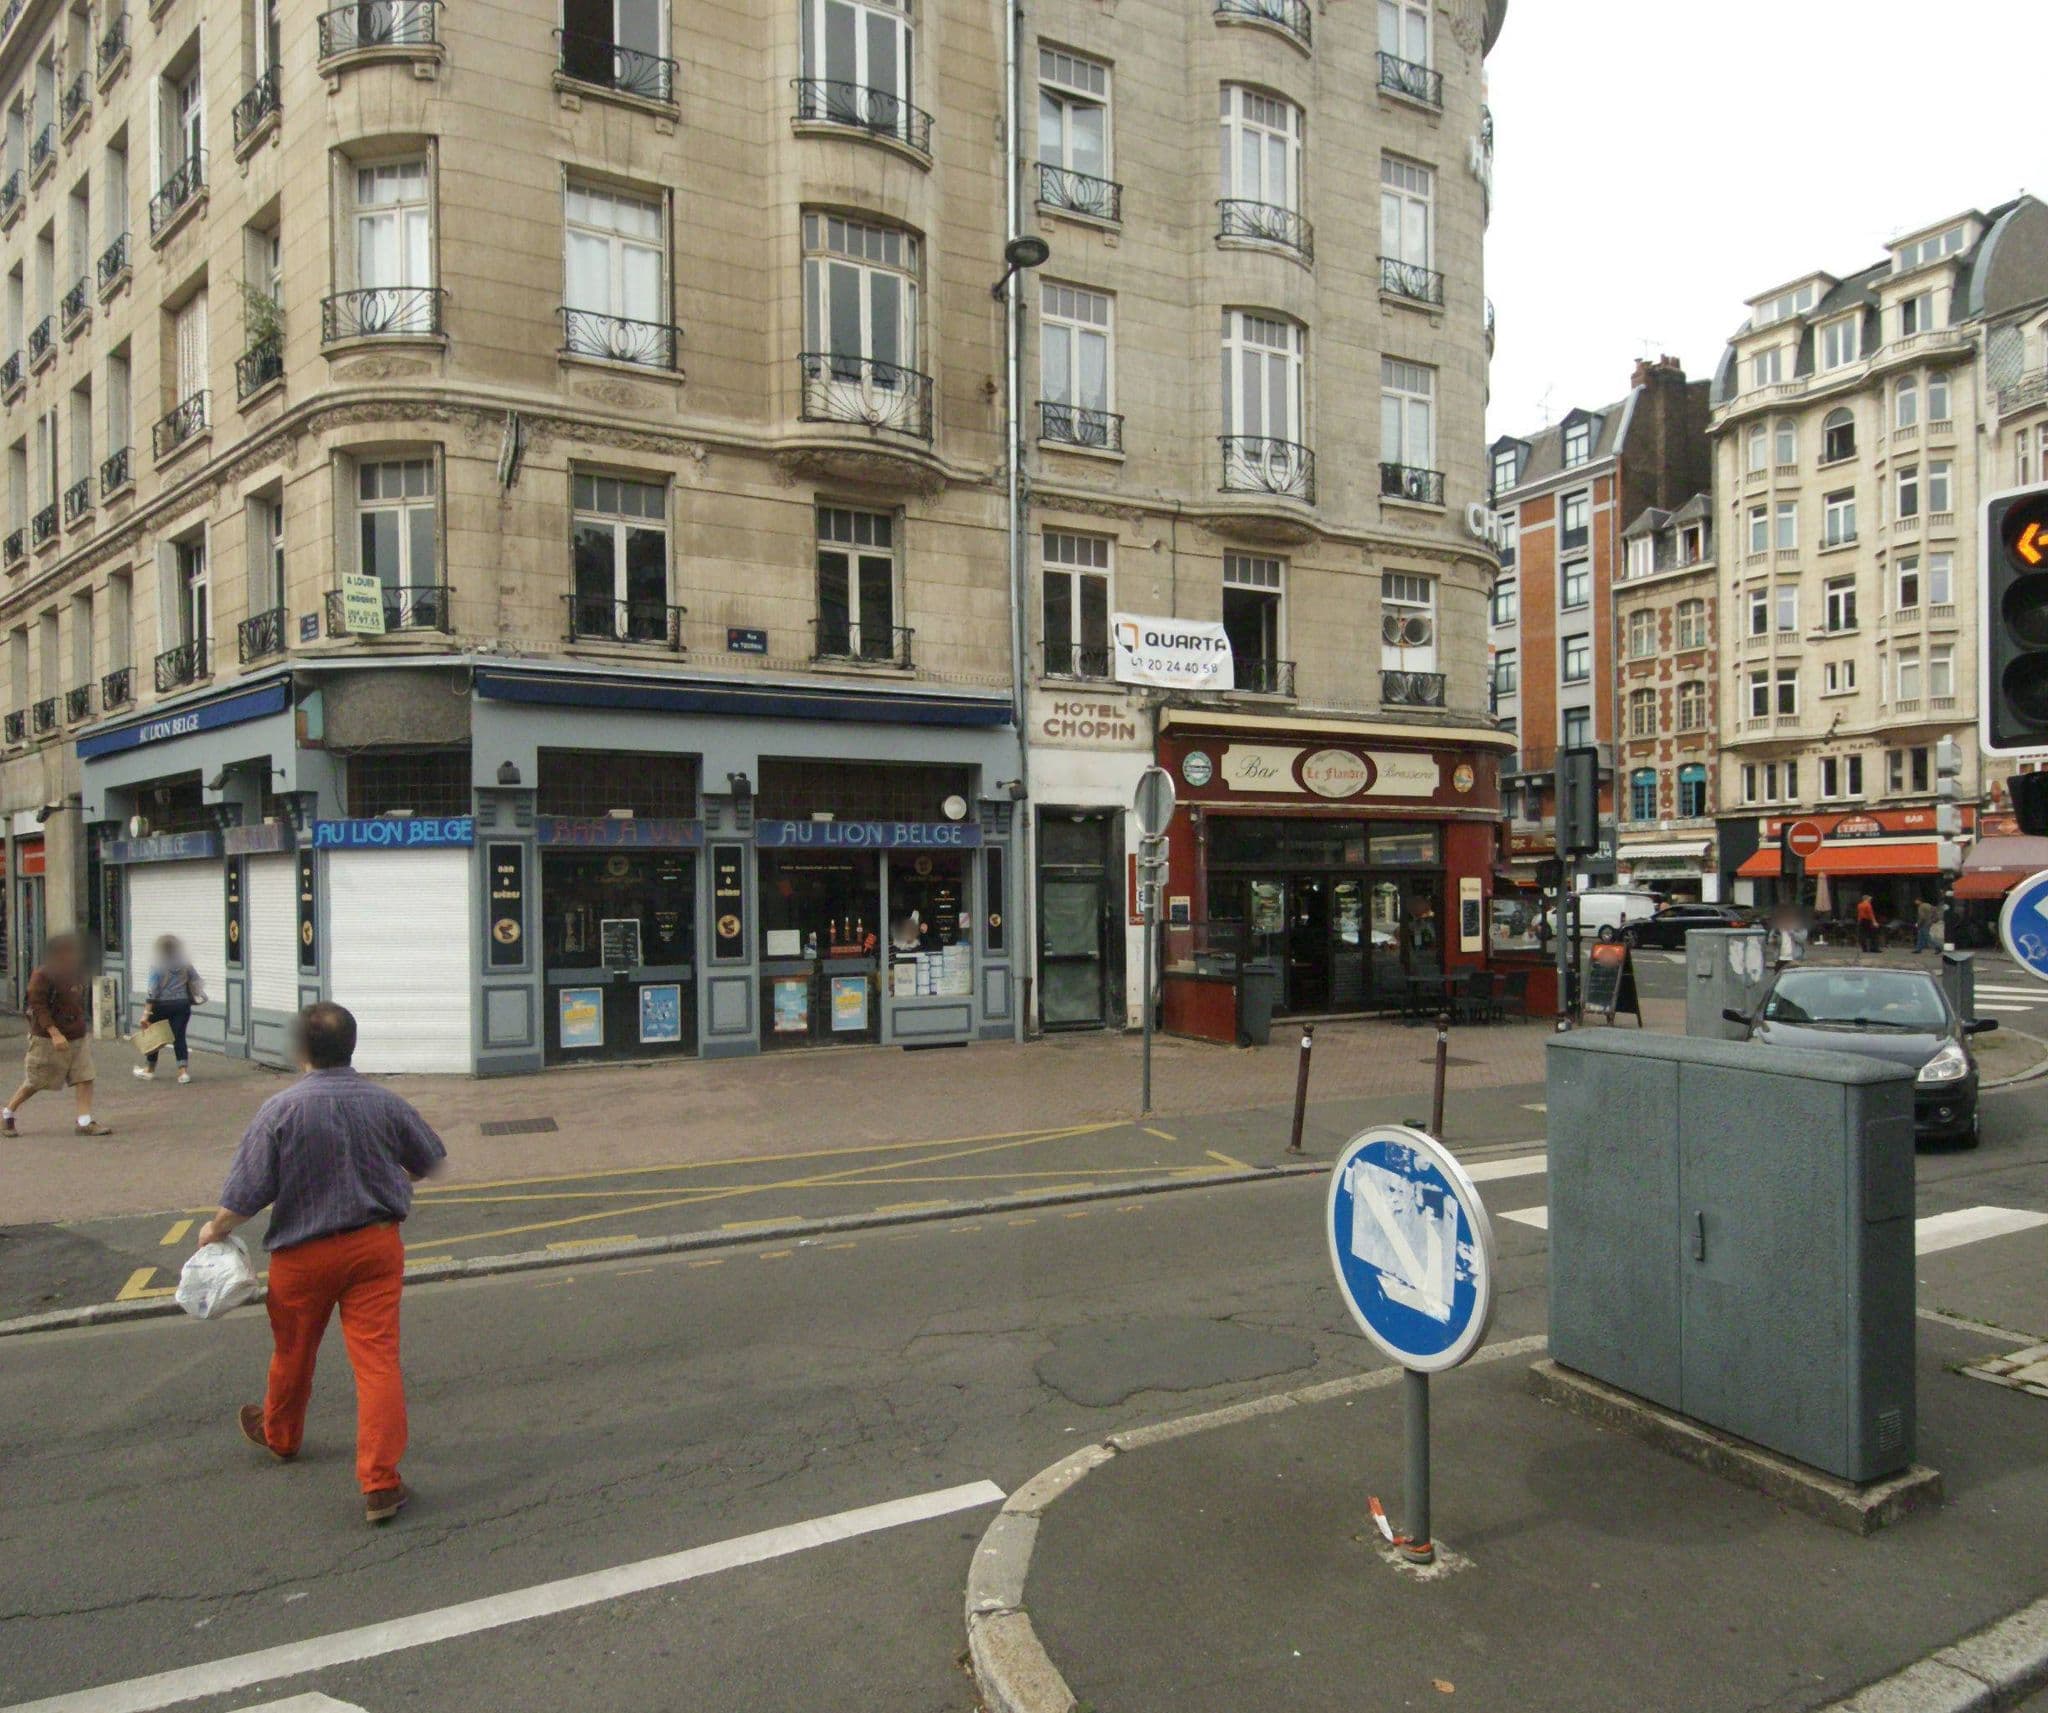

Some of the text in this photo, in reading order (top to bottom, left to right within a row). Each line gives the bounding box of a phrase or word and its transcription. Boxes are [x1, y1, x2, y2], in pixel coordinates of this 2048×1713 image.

[1145, 632, 1227, 652] QUARTA
[1148, 659, 1163, 671] 20
[1167, 660, 1181, 672] 24
[1184, 662, 1199, 674] 40
[1054, 702, 1126, 719] HOTEL
[150, 721, 170, 740] LION
[172, 714, 199, 735] BELGE
[1043, 719, 1136, 740] CHOPIN
[1235, 755, 1280, 778] Bar
[1306, 767, 1319, 780] Le
[1905, 815, 1923, 824] BAR
[315, 820, 473, 846] AU LION BELGE
[780, 823, 962, 846] AU LION BELGE
